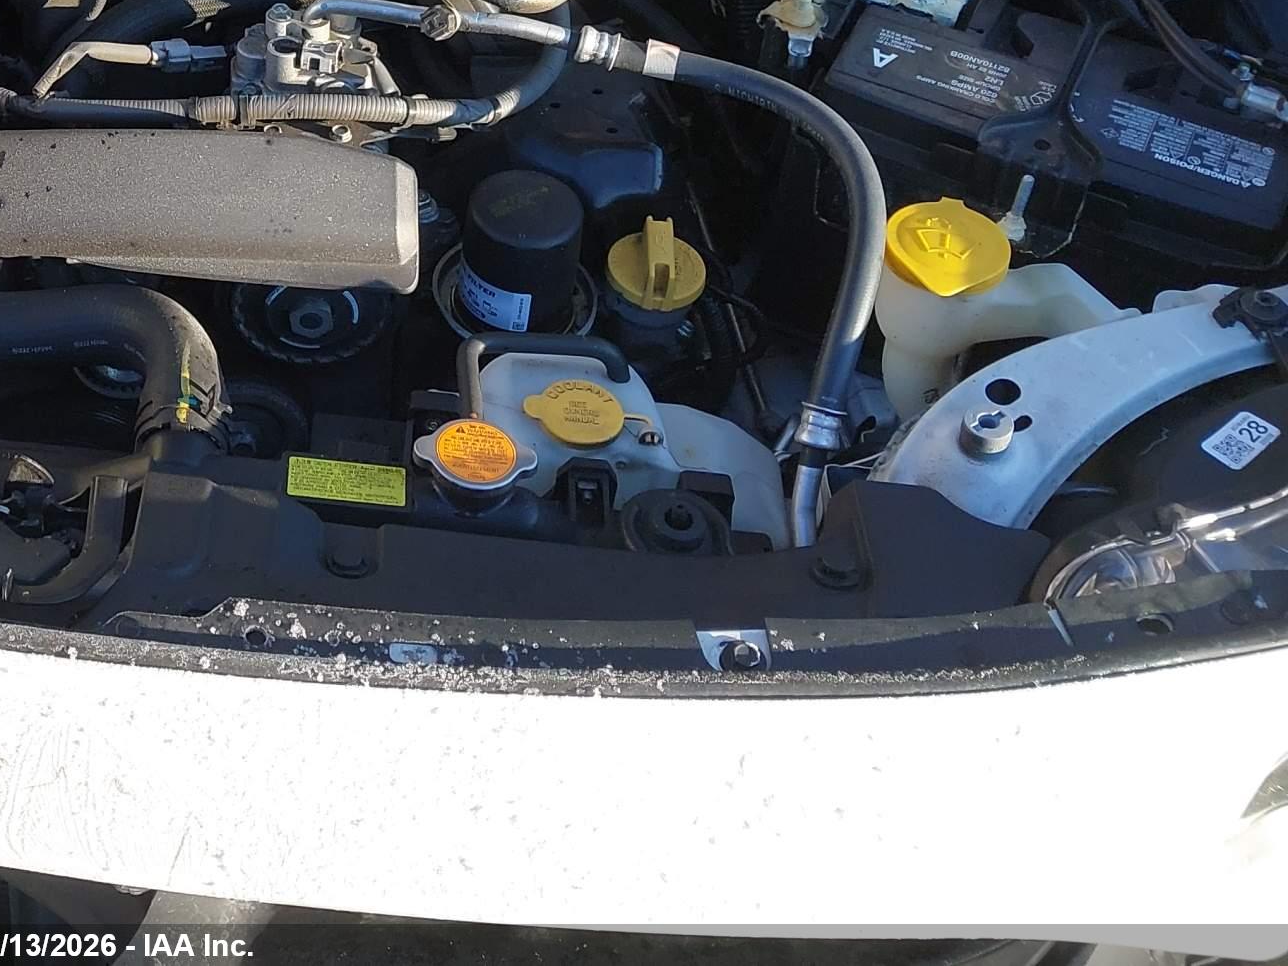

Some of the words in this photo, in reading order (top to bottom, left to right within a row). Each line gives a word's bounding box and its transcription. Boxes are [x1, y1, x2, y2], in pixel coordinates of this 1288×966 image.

[916, 75, 936, 86] AMPS
[951, 79, 980, 93] AMPS
[973, 79, 1001, 92] GROUP
[984, 76, 1004, 86] LN2
[546, 381, 614, 403] COOLANT
[1238, 421, 1269, 443] 28
